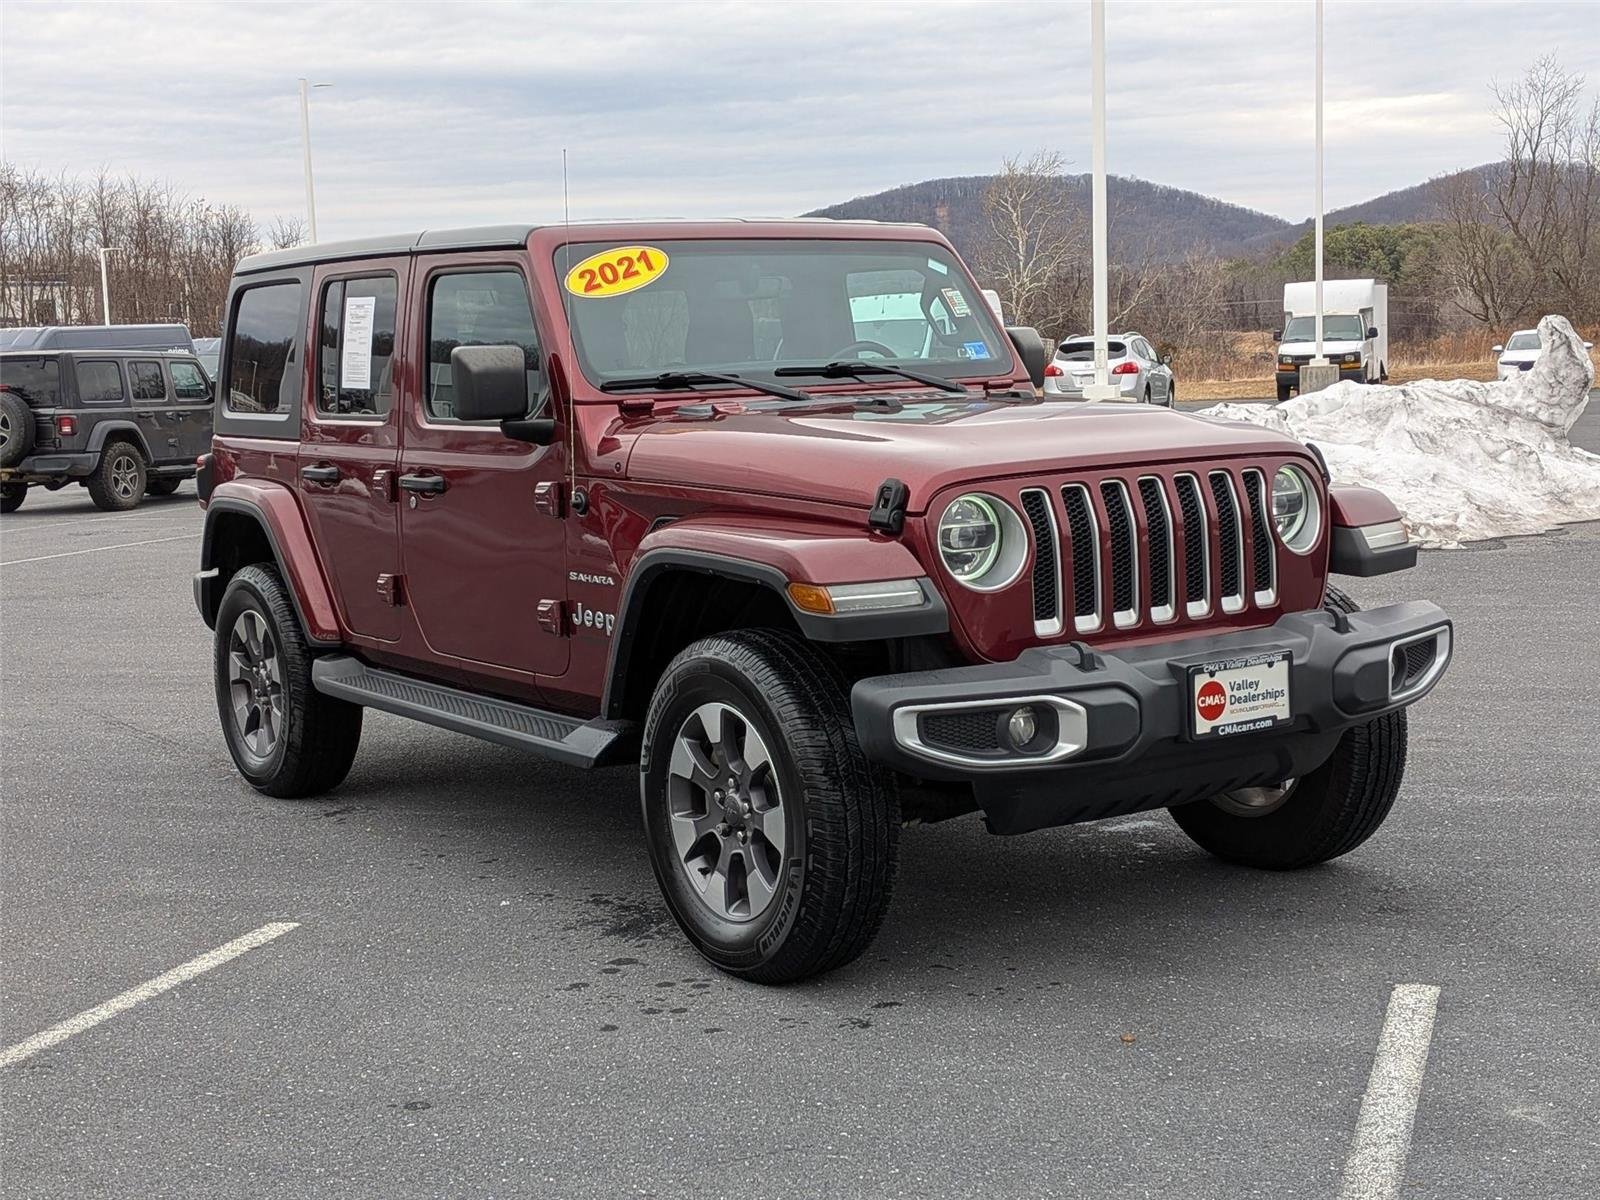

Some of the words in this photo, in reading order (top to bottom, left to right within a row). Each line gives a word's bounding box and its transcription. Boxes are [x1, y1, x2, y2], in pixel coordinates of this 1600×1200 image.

[578, 250, 655, 293] 2021
[569, 571, 615, 585] SAHARA
[572, 603, 615, 636] Jeep
[1226, 658, 1247, 670] Valley
[1229, 679, 1260, 692] Valley
[1198, 694, 1225, 707] CMA's
[1229, 688, 1285, 706] Dealerships
[1218, 719, 1273, 735] CMAcars.com
